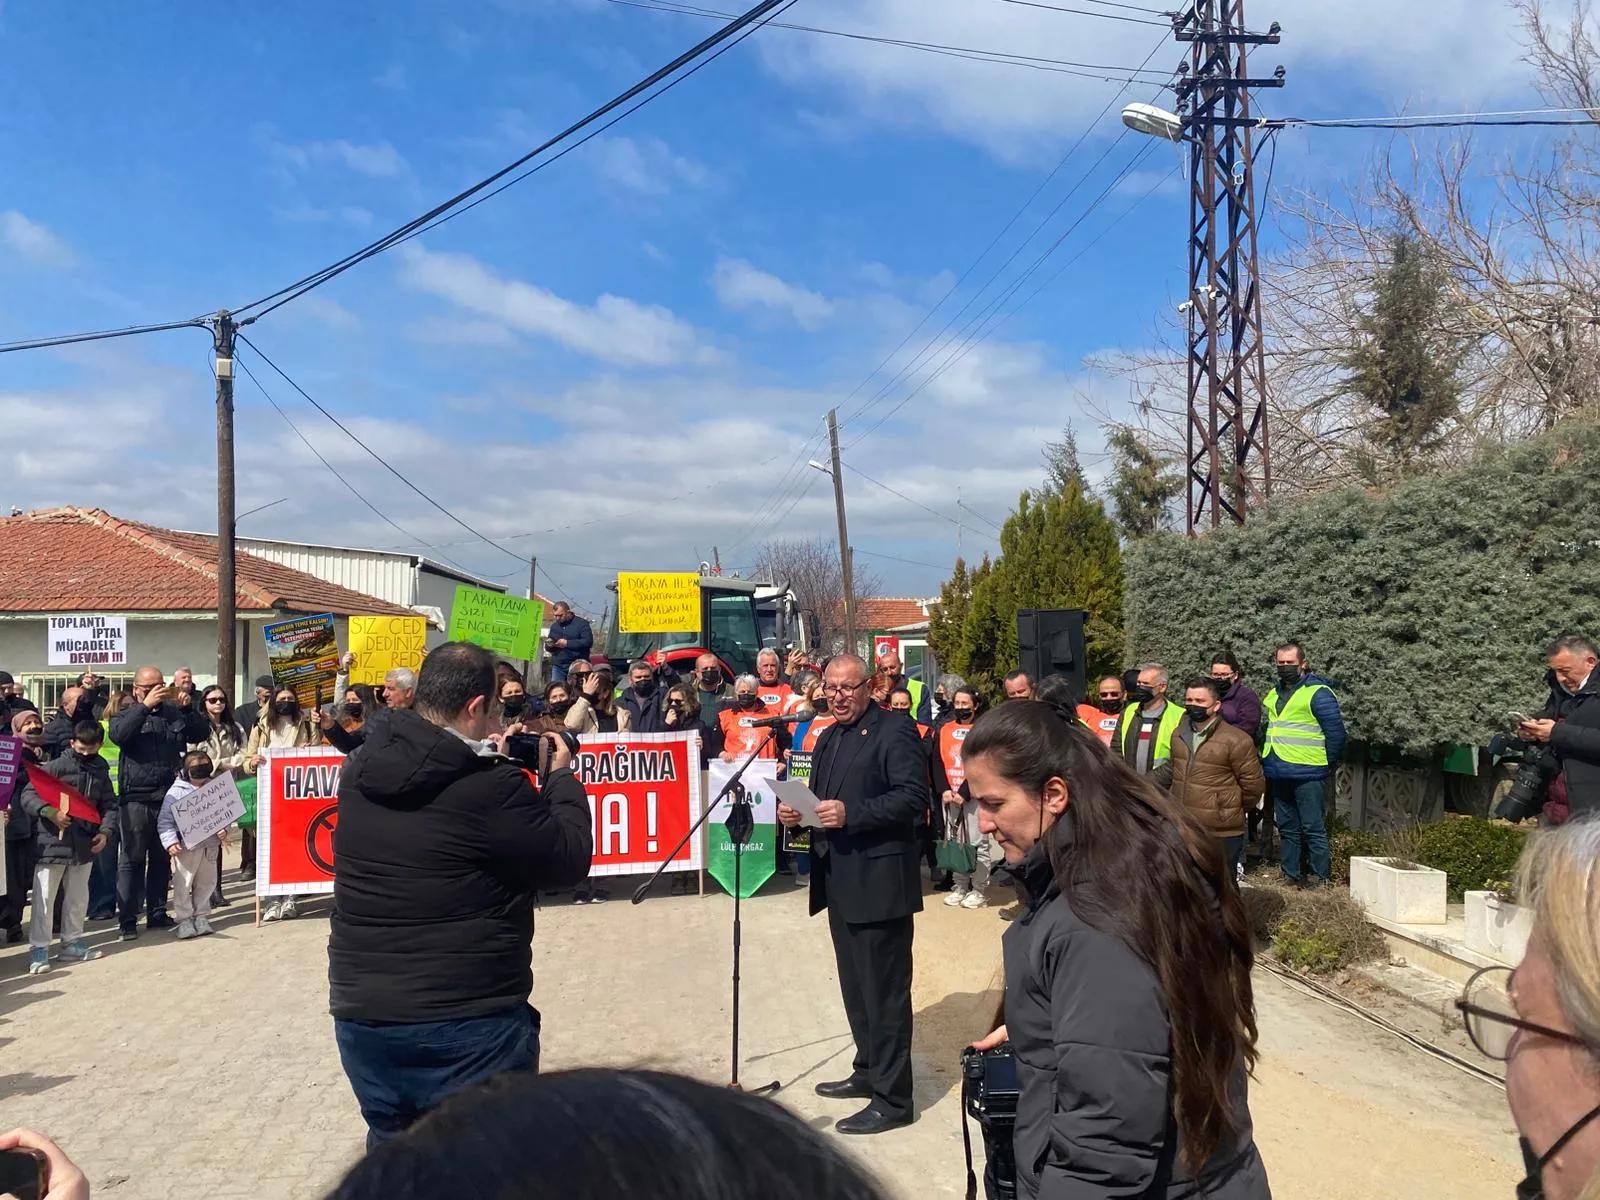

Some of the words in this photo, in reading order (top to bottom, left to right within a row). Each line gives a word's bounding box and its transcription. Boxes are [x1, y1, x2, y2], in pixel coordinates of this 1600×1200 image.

[50, 617, 105, 628] TOPLANTI
[92, 627, 122, 639] İPTAL
[55, 639, 116, 652] MÜCADELE
[70, 652, 109, 663] DEVAM
[391, 651, 421, 668] RED
[364, 670, 386, 685] DE
[791, 769, 811, 778] HAYI
[284, 765, 340, 800] HAV
